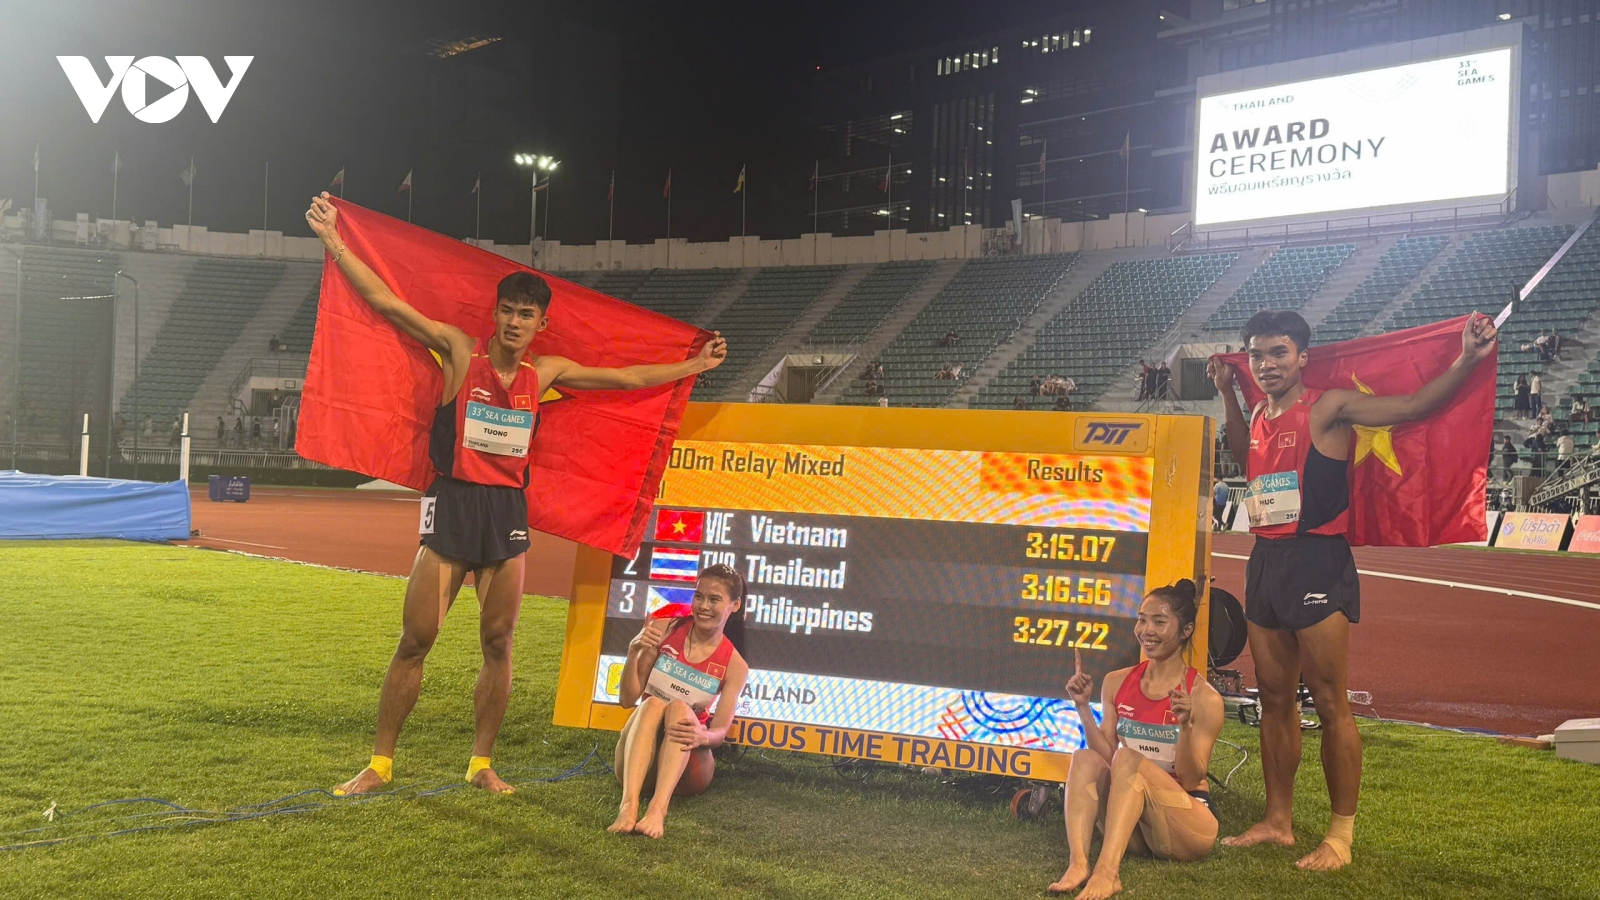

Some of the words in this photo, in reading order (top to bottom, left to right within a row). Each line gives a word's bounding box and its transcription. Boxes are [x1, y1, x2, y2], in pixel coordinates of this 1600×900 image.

[1457, 75, 1495, 86] GAMES
[1233, 95, 1294, 111] THAILAND
[1209, 118, 1330, 153] AWARD
[1209, 136, 1386, 178] CEREMONY
[485, 410, 499, 421] SEA
[501, 413, 525, 424] GAMES
[483, 427, 508, 437] TUONG
[669, 447, 714, 471] 00m
[721, 449, 777, 479] Relay
[784, 452, 845, 477] Mixed
[1027, 459, 1103, 483] Results
[1265, 477, 1291, 489] GAMES
[425, 502, 434, 529] 5
[706, 511, 734, 545] VIE
[751, 515, 847, 548] Vietnam
[1026, 532, 1116, 563] 3:15.07
[746, 555, 846, 589] Thailand
[1021, 574, 1111, 605] 3:16.56
[619, 582, 636, 613] 3
[745, 594, 873, 634] Philippines
[1013, 616, 1109, 650] 3:27.22
[673, 665, 687, 679] SEA
[688, 673, 712, 689] GAMES
[670, 683, 690, 696] NGOC
[740, 684, 816, 706] AILAND
[1132, 726, 1147, 736] SEA
[1148, 729, 1176, 740] GAMES
[724, 719, 806, 750] CIOUS
[815, 727, 883, 759] TIME
[893, 736, 1031, 776] TRADING
[1139, 745, 1160, 753] HANG
